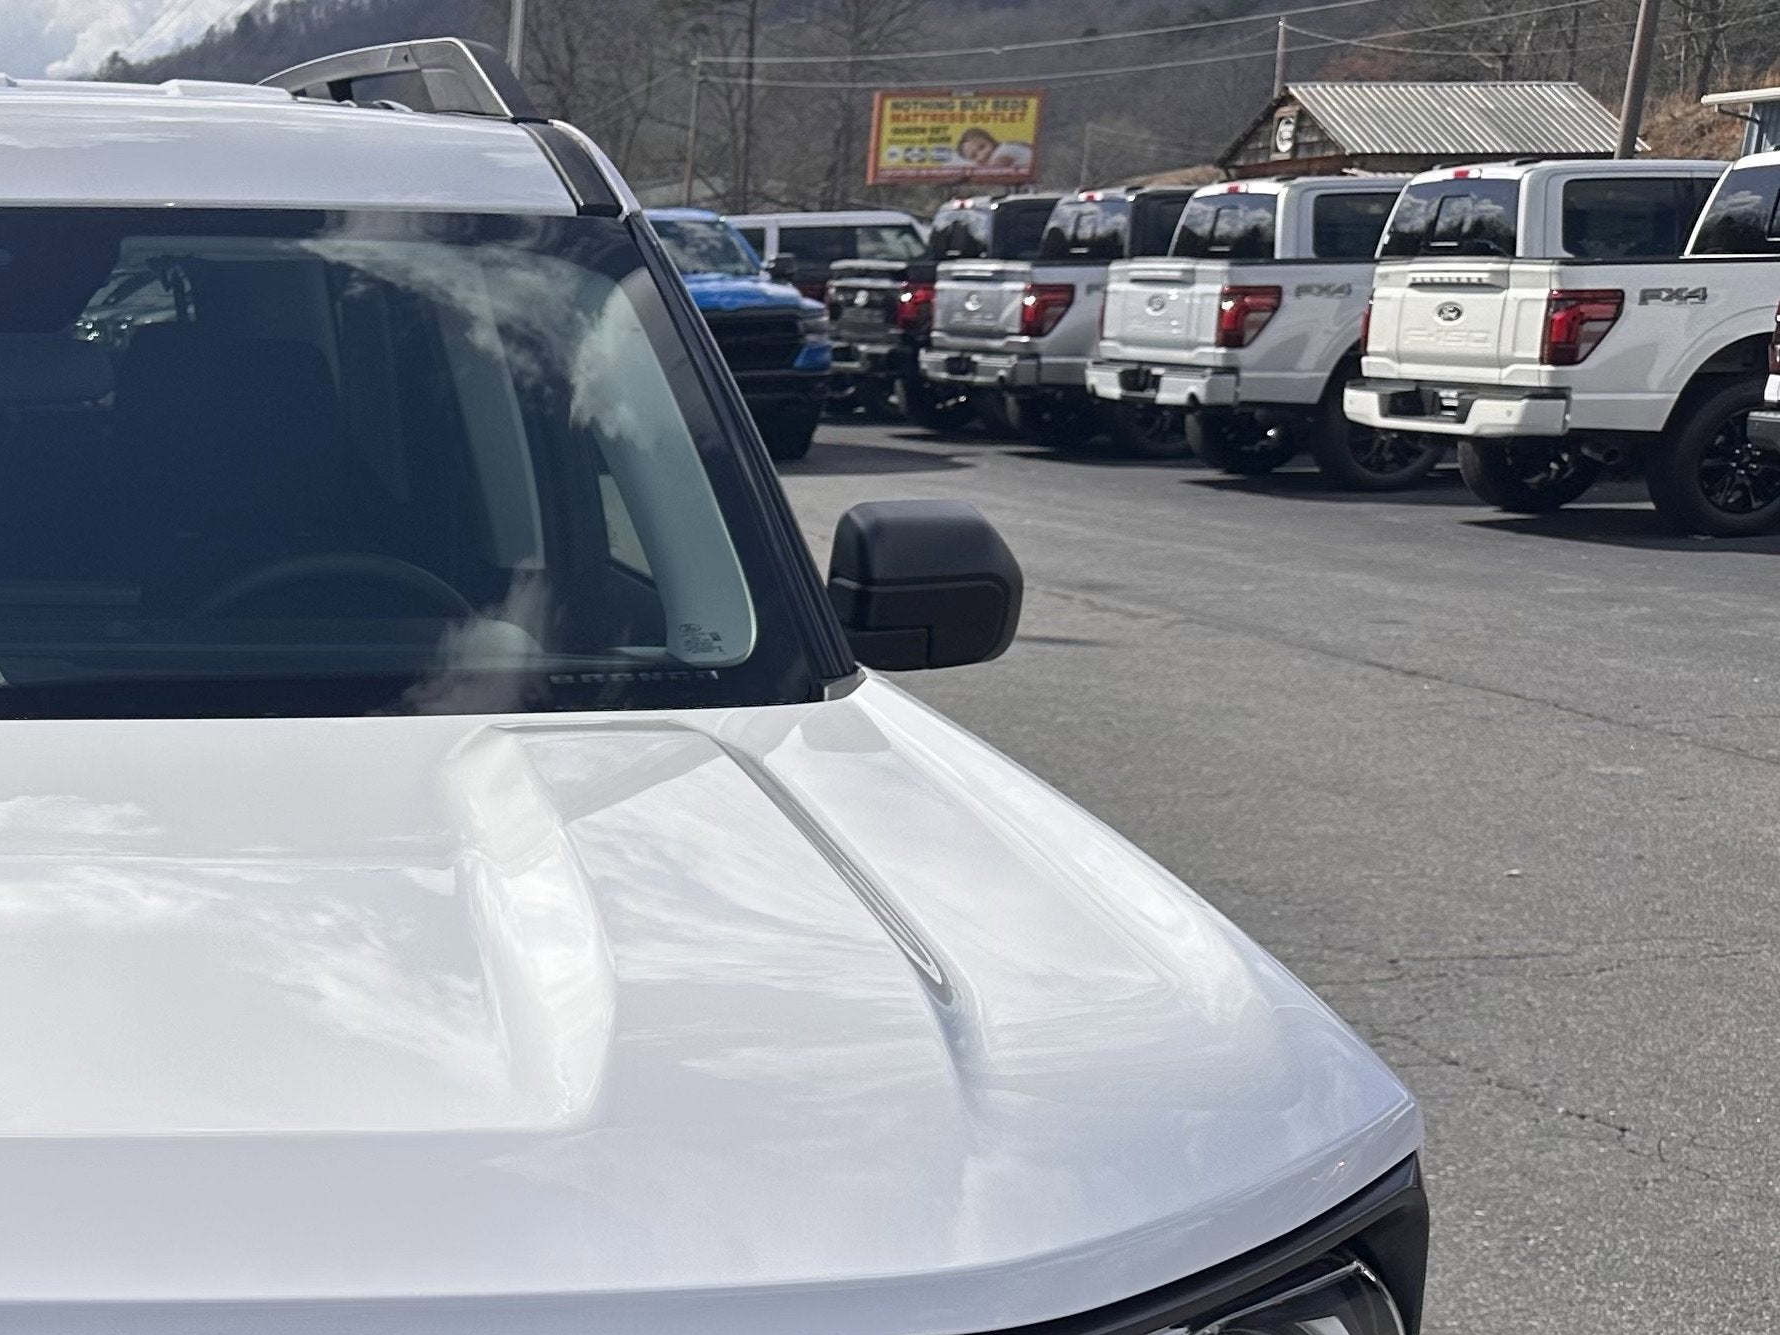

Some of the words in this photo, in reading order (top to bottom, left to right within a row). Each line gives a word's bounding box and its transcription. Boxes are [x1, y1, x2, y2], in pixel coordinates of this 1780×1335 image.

[890, 100, 955, 111] NOTHING
[960, 100, 988, 111] BUT
[890, 112, 966, 123] MATTRESS
[970, 112, 1027, 123] OUTLET
[1638, 287, 1708, 306] FX4
